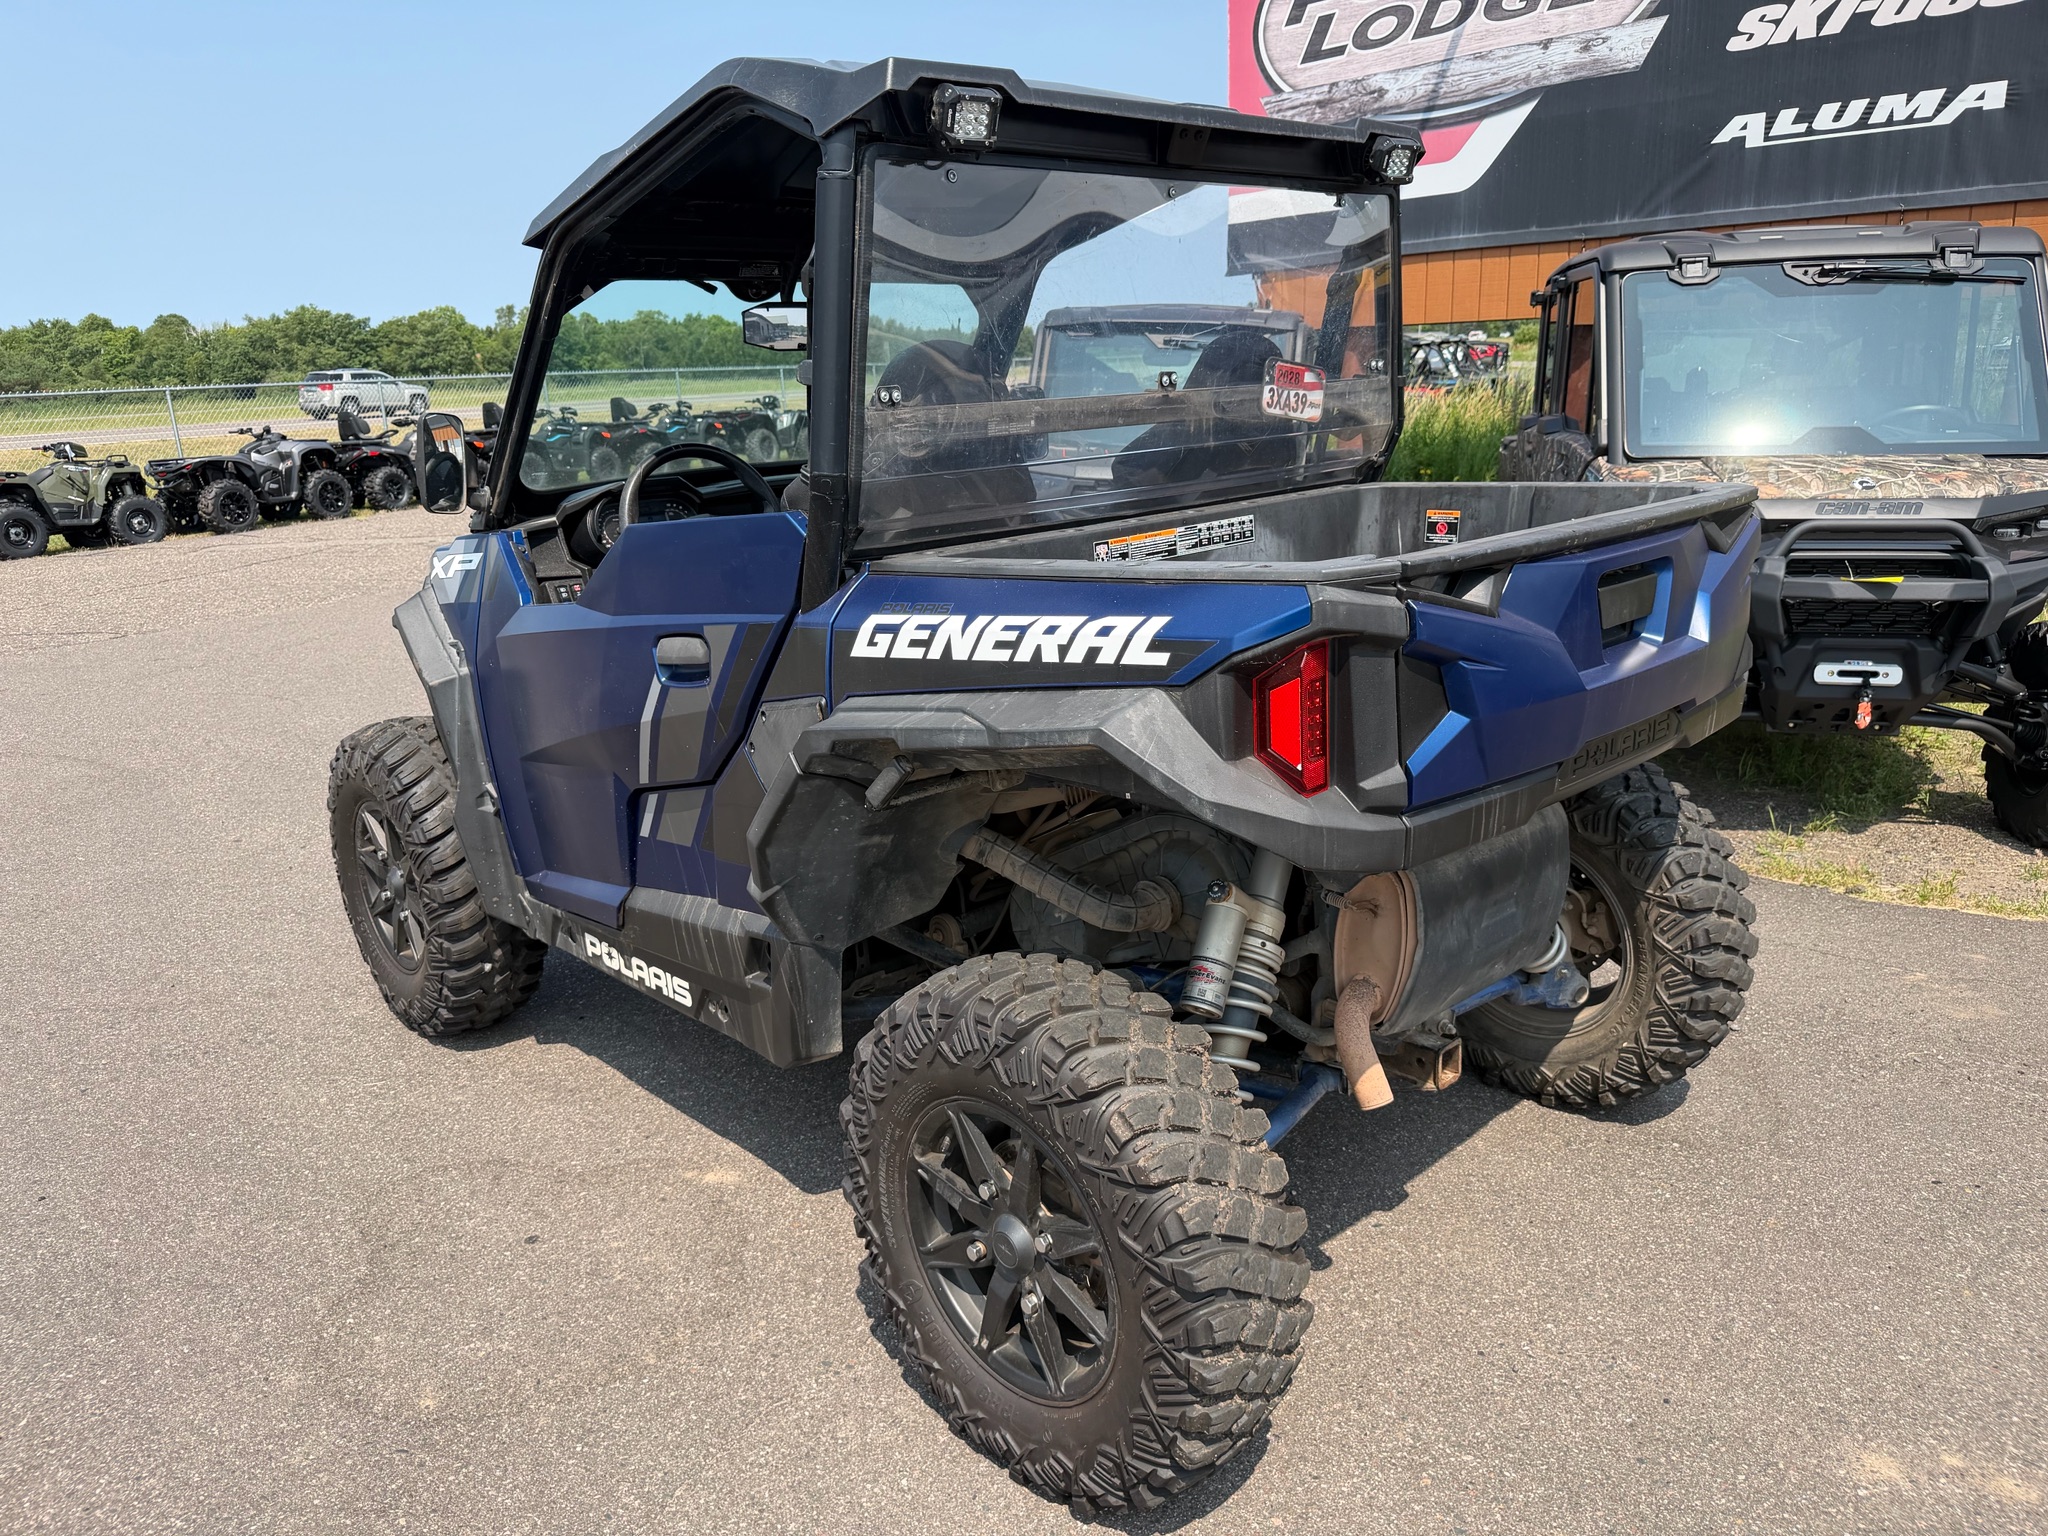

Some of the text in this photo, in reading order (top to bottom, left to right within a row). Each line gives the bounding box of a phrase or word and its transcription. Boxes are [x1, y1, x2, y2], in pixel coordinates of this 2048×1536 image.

[1299, 0, 1597, 66] LOD
[1711, 80, 2008, 148] ALUMA
[1266, 386, 1308, 415] 3XA39
[1277, 369, 1301, 386] 2028
[431, 552, 484, 579] XP
[879, 602, 954, 615] POLARIS
[850, 614, 1173, 667] GENERAL
[1572, 712, 1671, 777] POLARIS
[584, 931, 693, 1008] POLARIS
